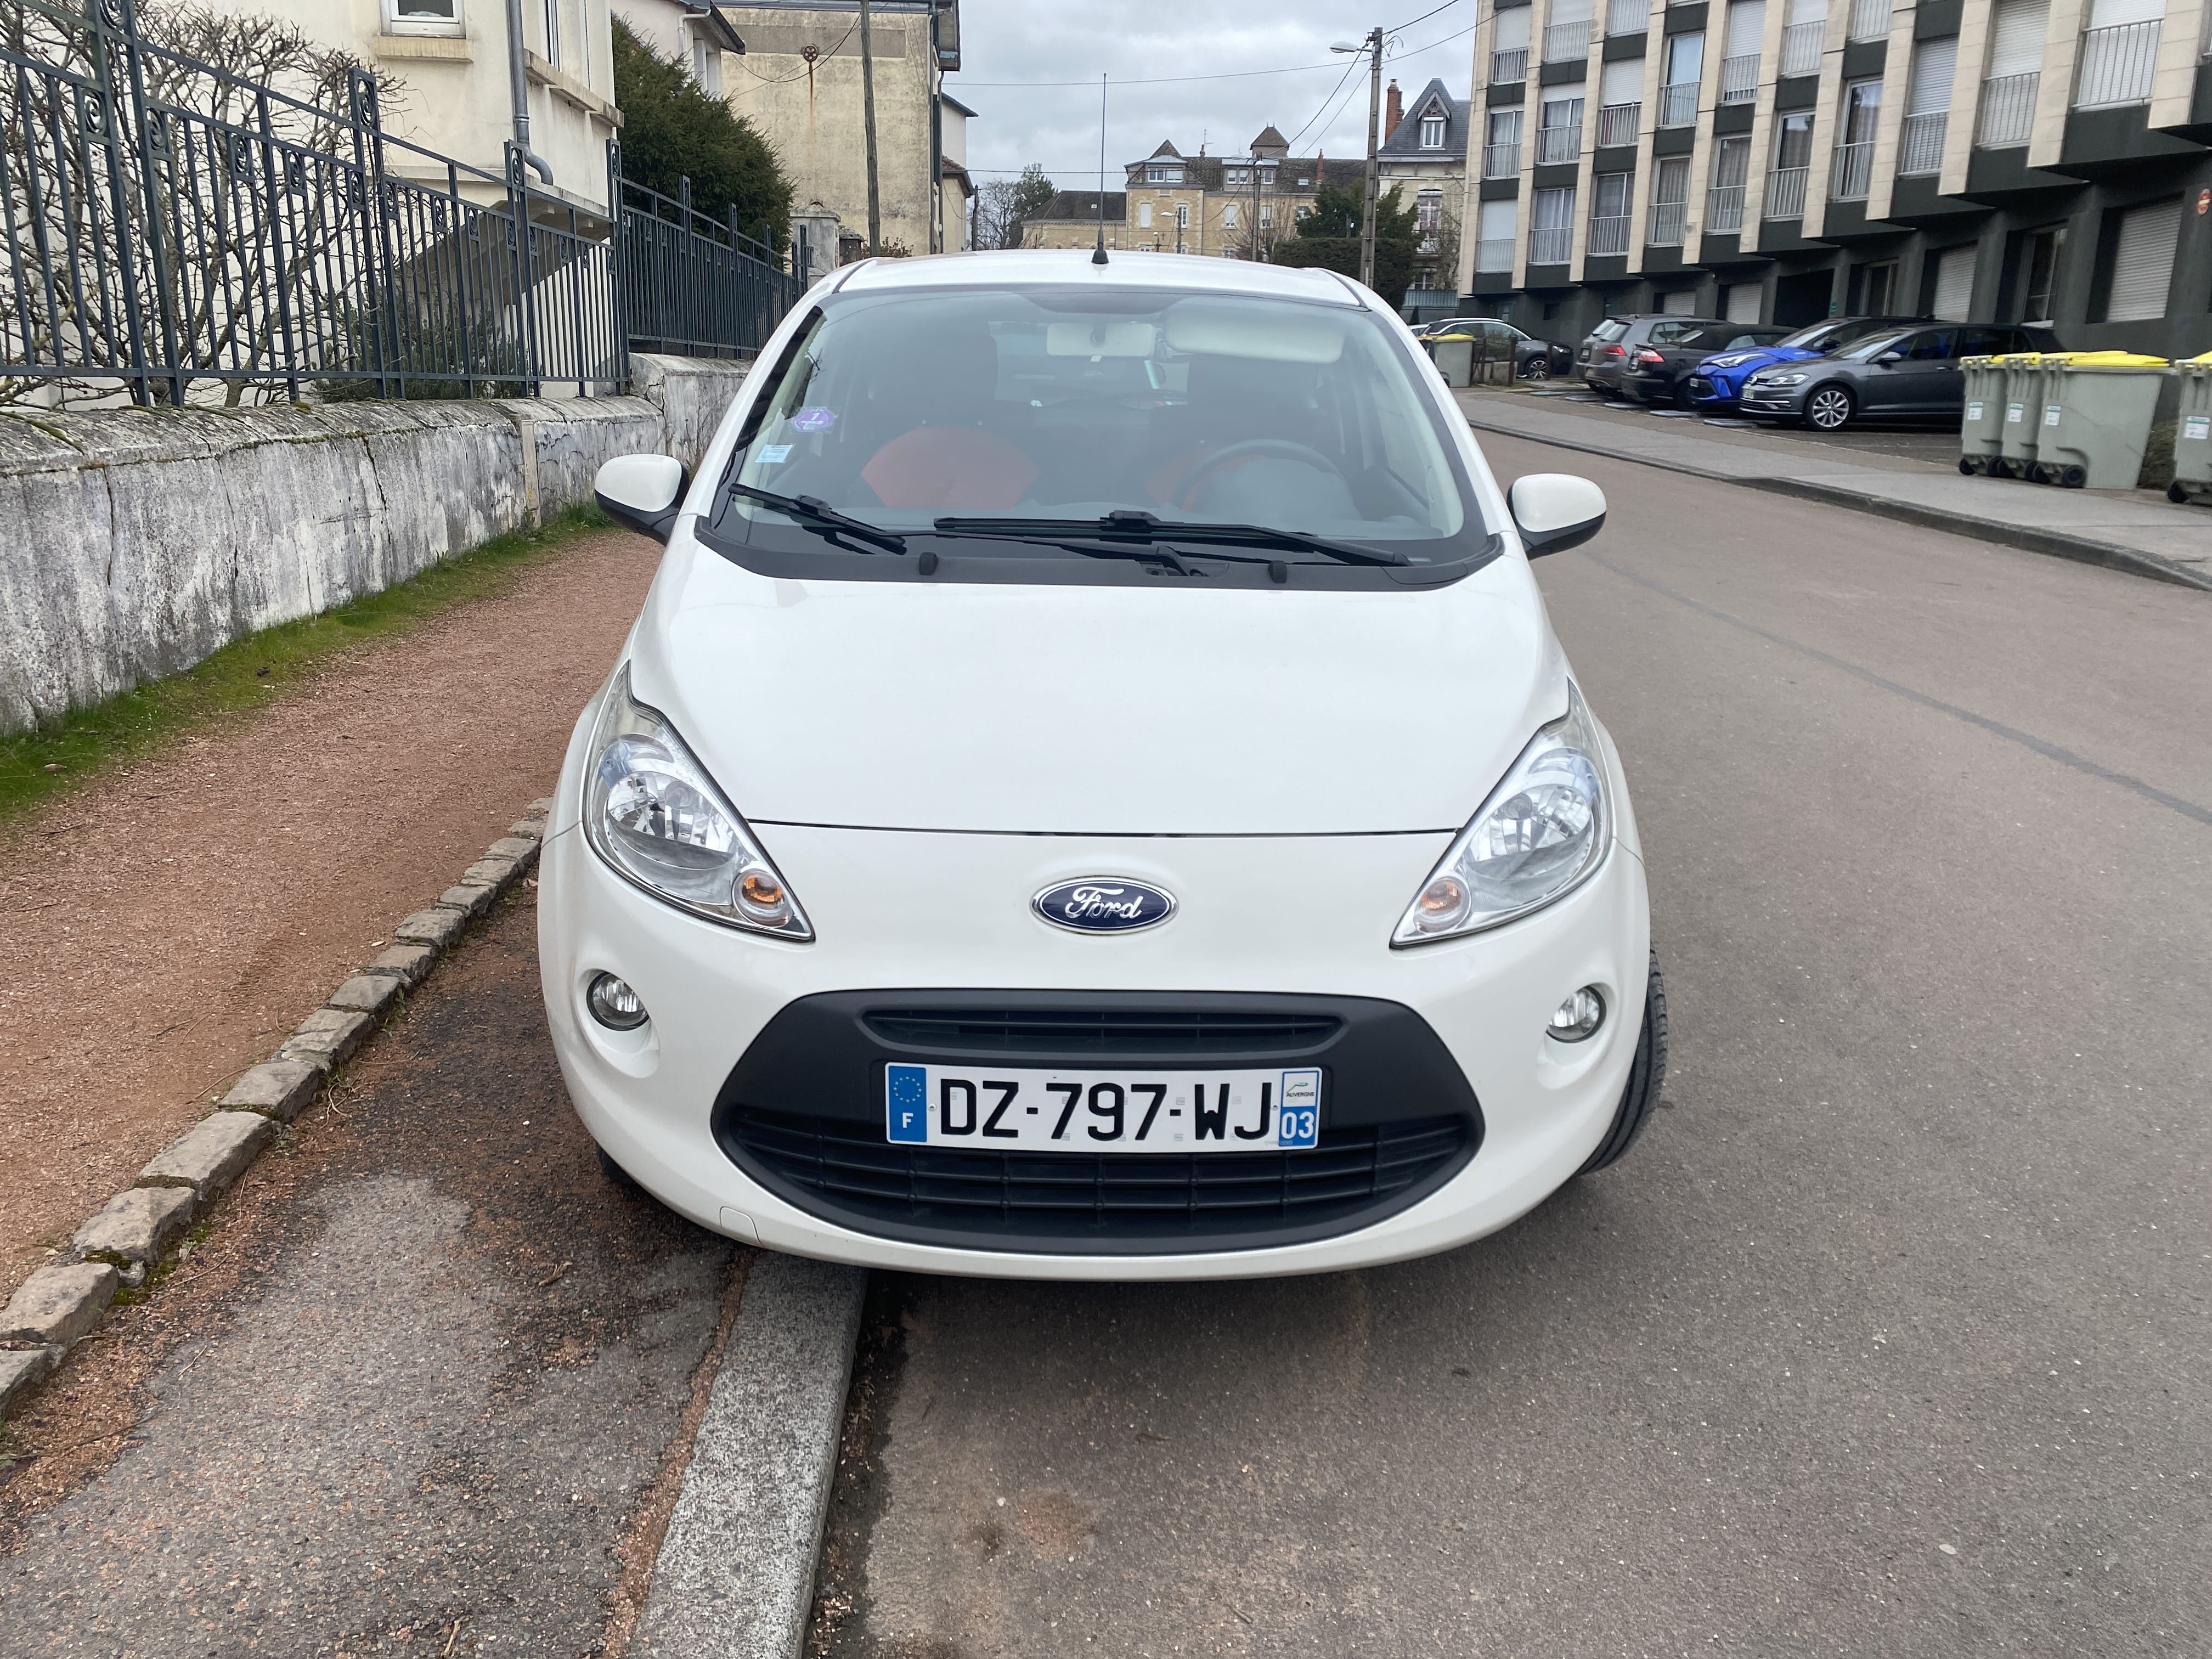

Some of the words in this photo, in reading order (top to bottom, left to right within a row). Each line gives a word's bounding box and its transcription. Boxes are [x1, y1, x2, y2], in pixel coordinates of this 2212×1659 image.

[1065, 887, 1144, 919] Ford
[902, 1113, 914, 1128] F
[941, 1079, 1272, 1142] DZ-797-WJ
[1282, 1111, 1314, 1139] 03
